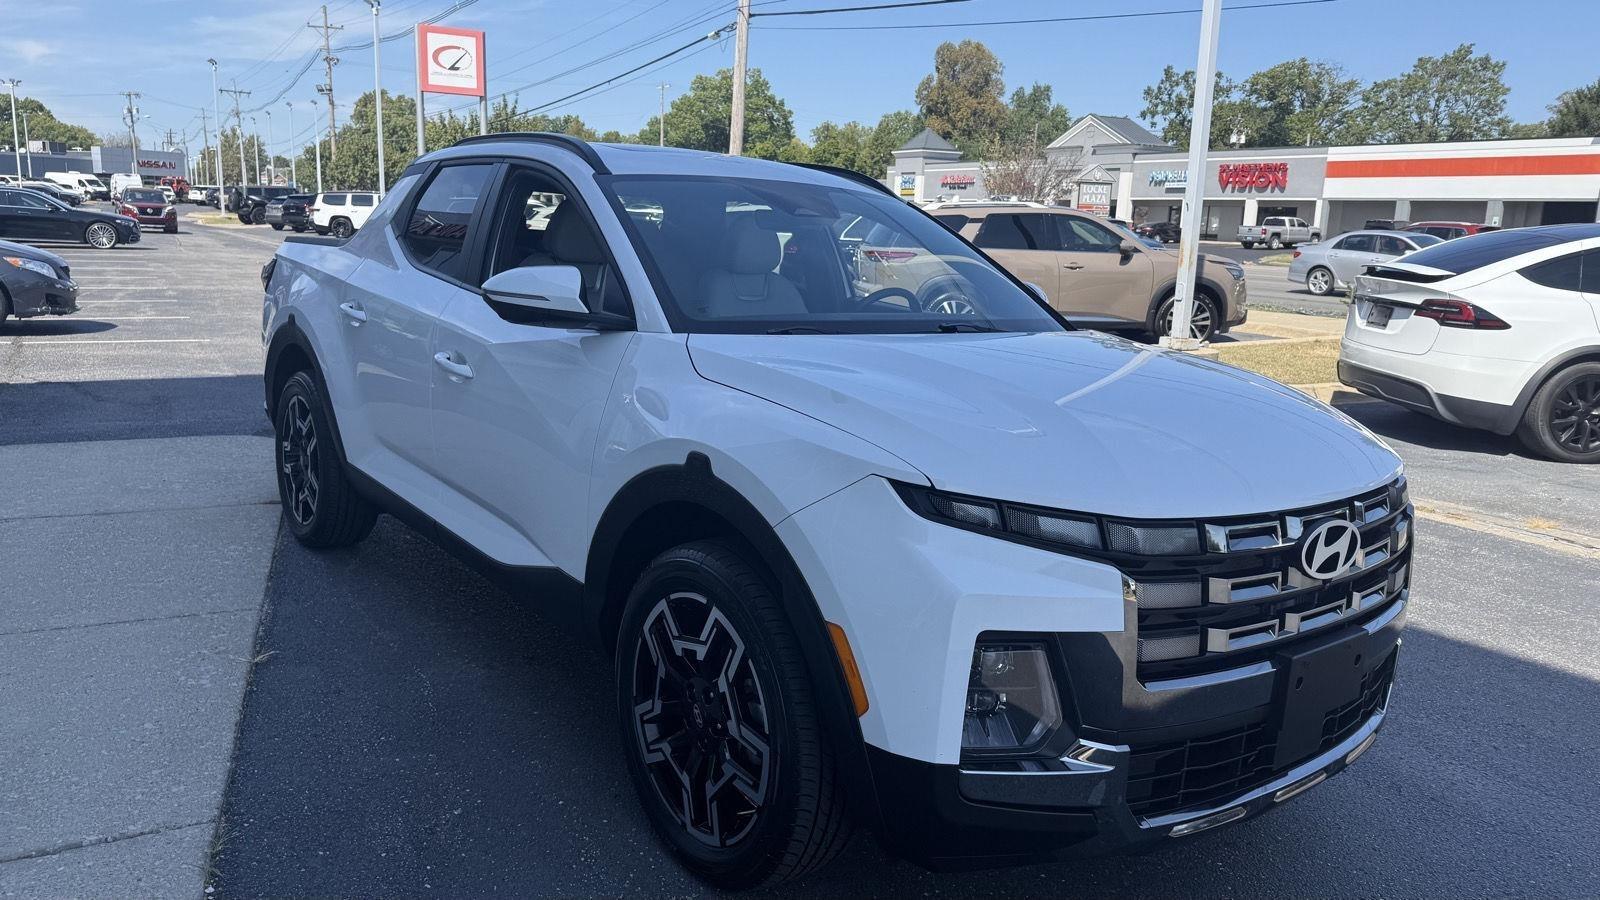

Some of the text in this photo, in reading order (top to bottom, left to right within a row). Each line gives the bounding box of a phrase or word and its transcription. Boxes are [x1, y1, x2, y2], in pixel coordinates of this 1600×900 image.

[137, 160, 176, 169] NISSAN
[1218, 170, 1288, 190] VISION
[1083, 184, 1107, 194] LOCKE
[1082, 194, 1106, 203] PLAZA
